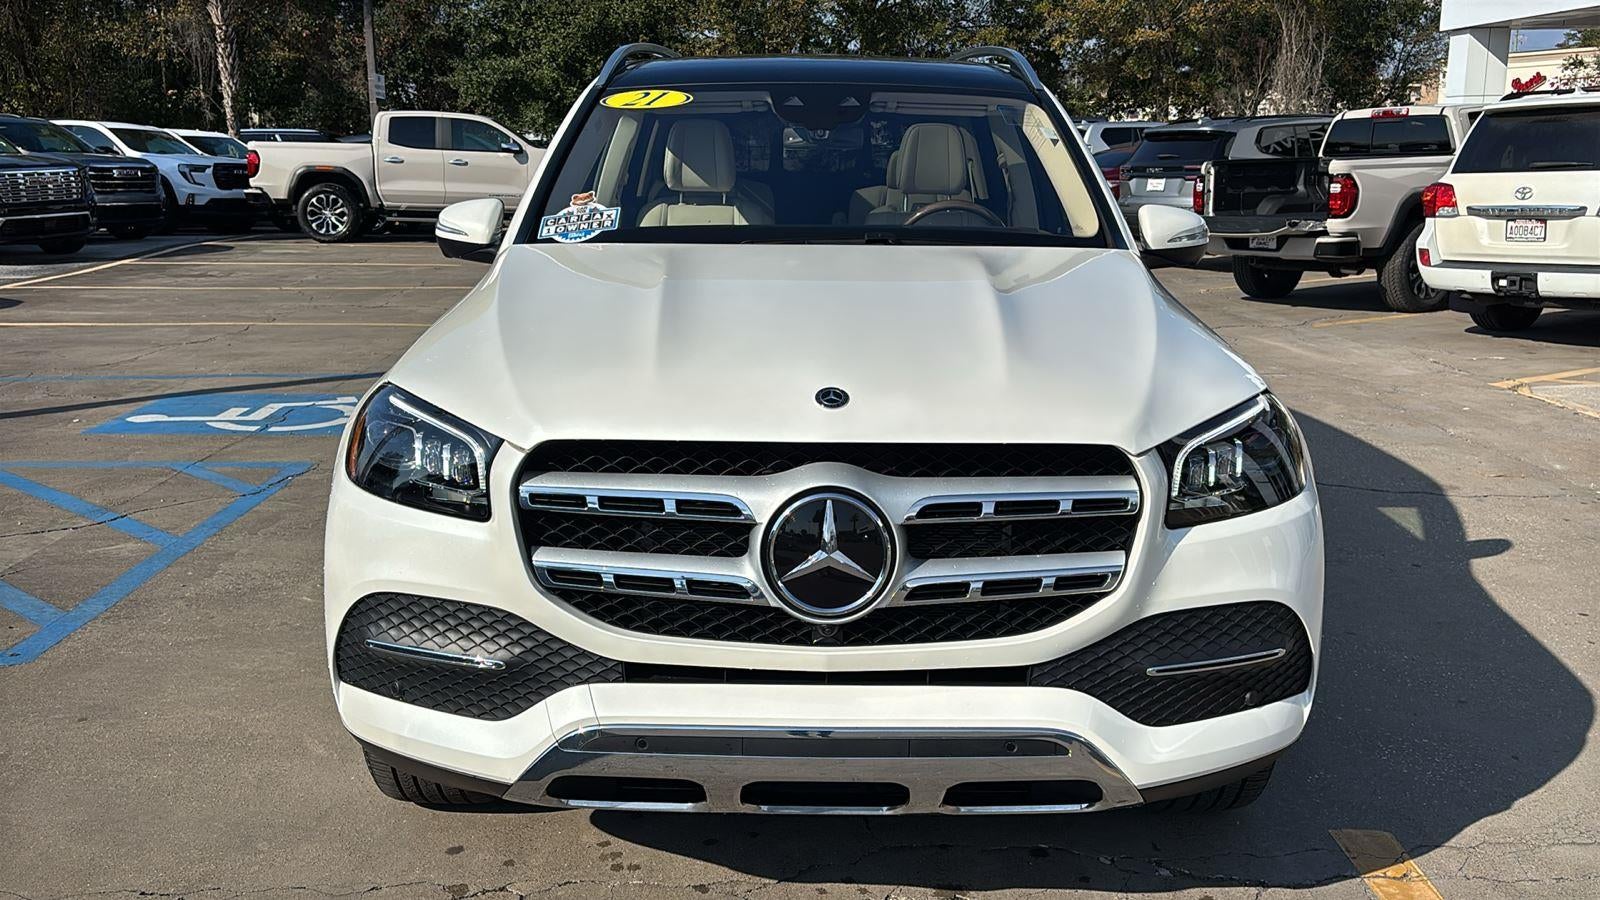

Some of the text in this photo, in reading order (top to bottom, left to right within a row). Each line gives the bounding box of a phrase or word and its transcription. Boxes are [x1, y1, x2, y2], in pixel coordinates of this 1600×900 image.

[620, 92, 669, 106] 21
[546, 212, 614, 227] CARFAX
[556, 220, 613, 233] OWNER
